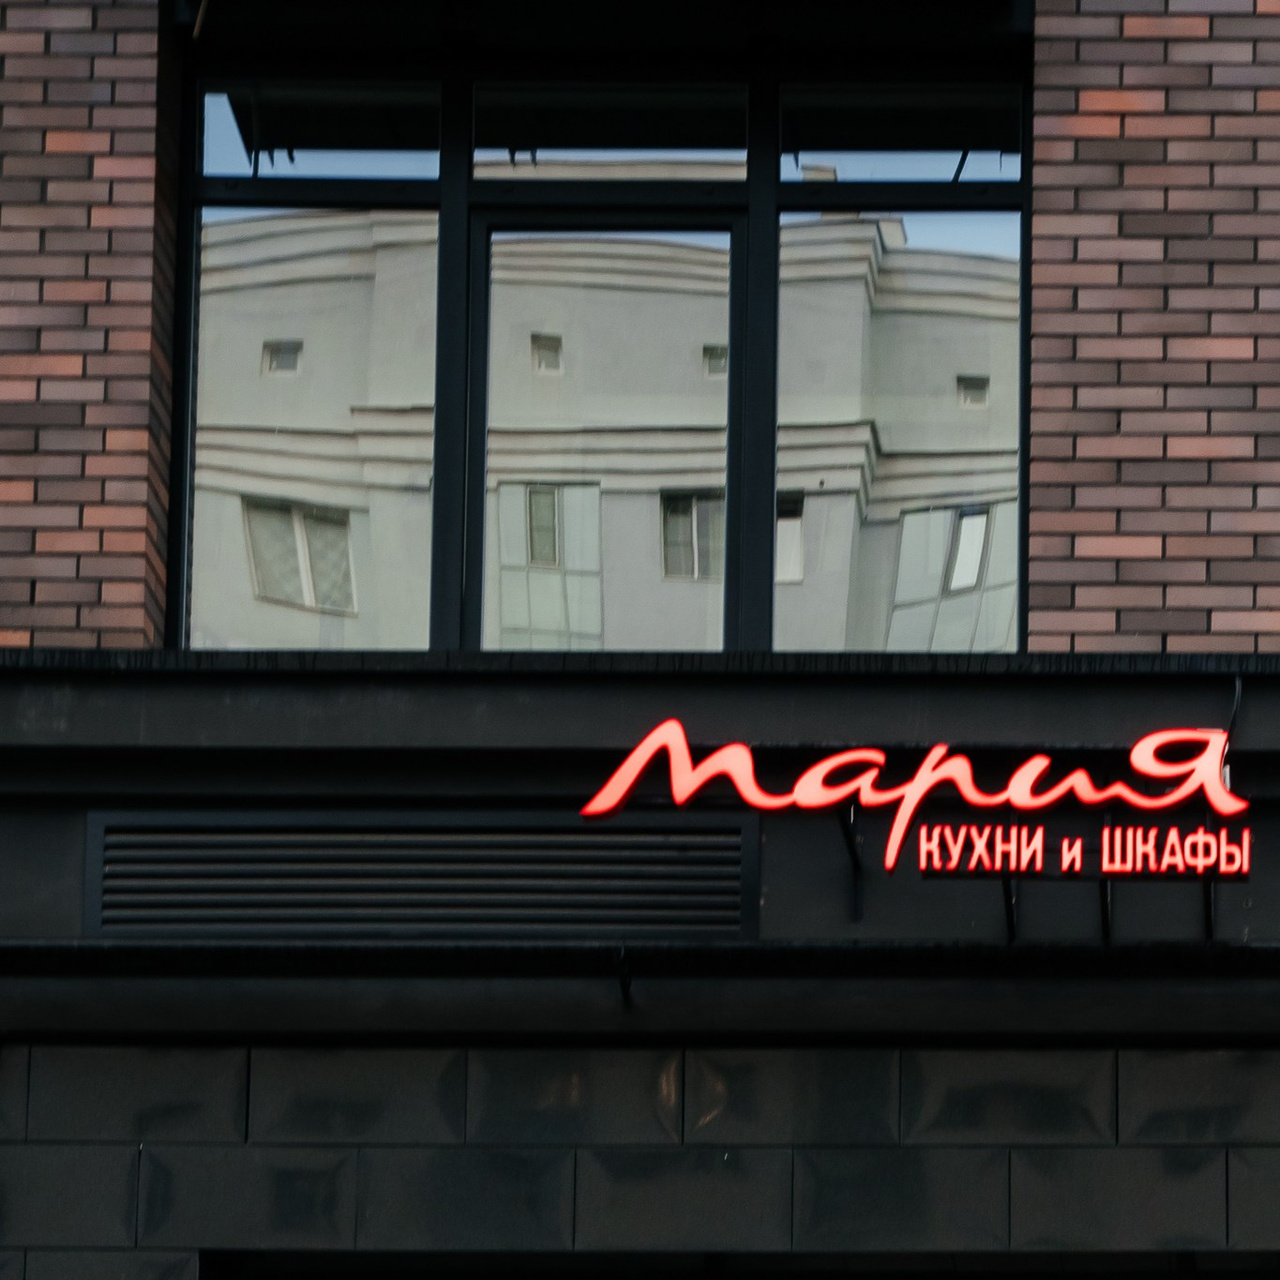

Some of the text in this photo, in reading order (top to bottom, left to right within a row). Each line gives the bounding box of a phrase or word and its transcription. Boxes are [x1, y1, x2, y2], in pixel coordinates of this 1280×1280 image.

[918, 824, 1251, 873] КУХНИ и ШКАФЫ
